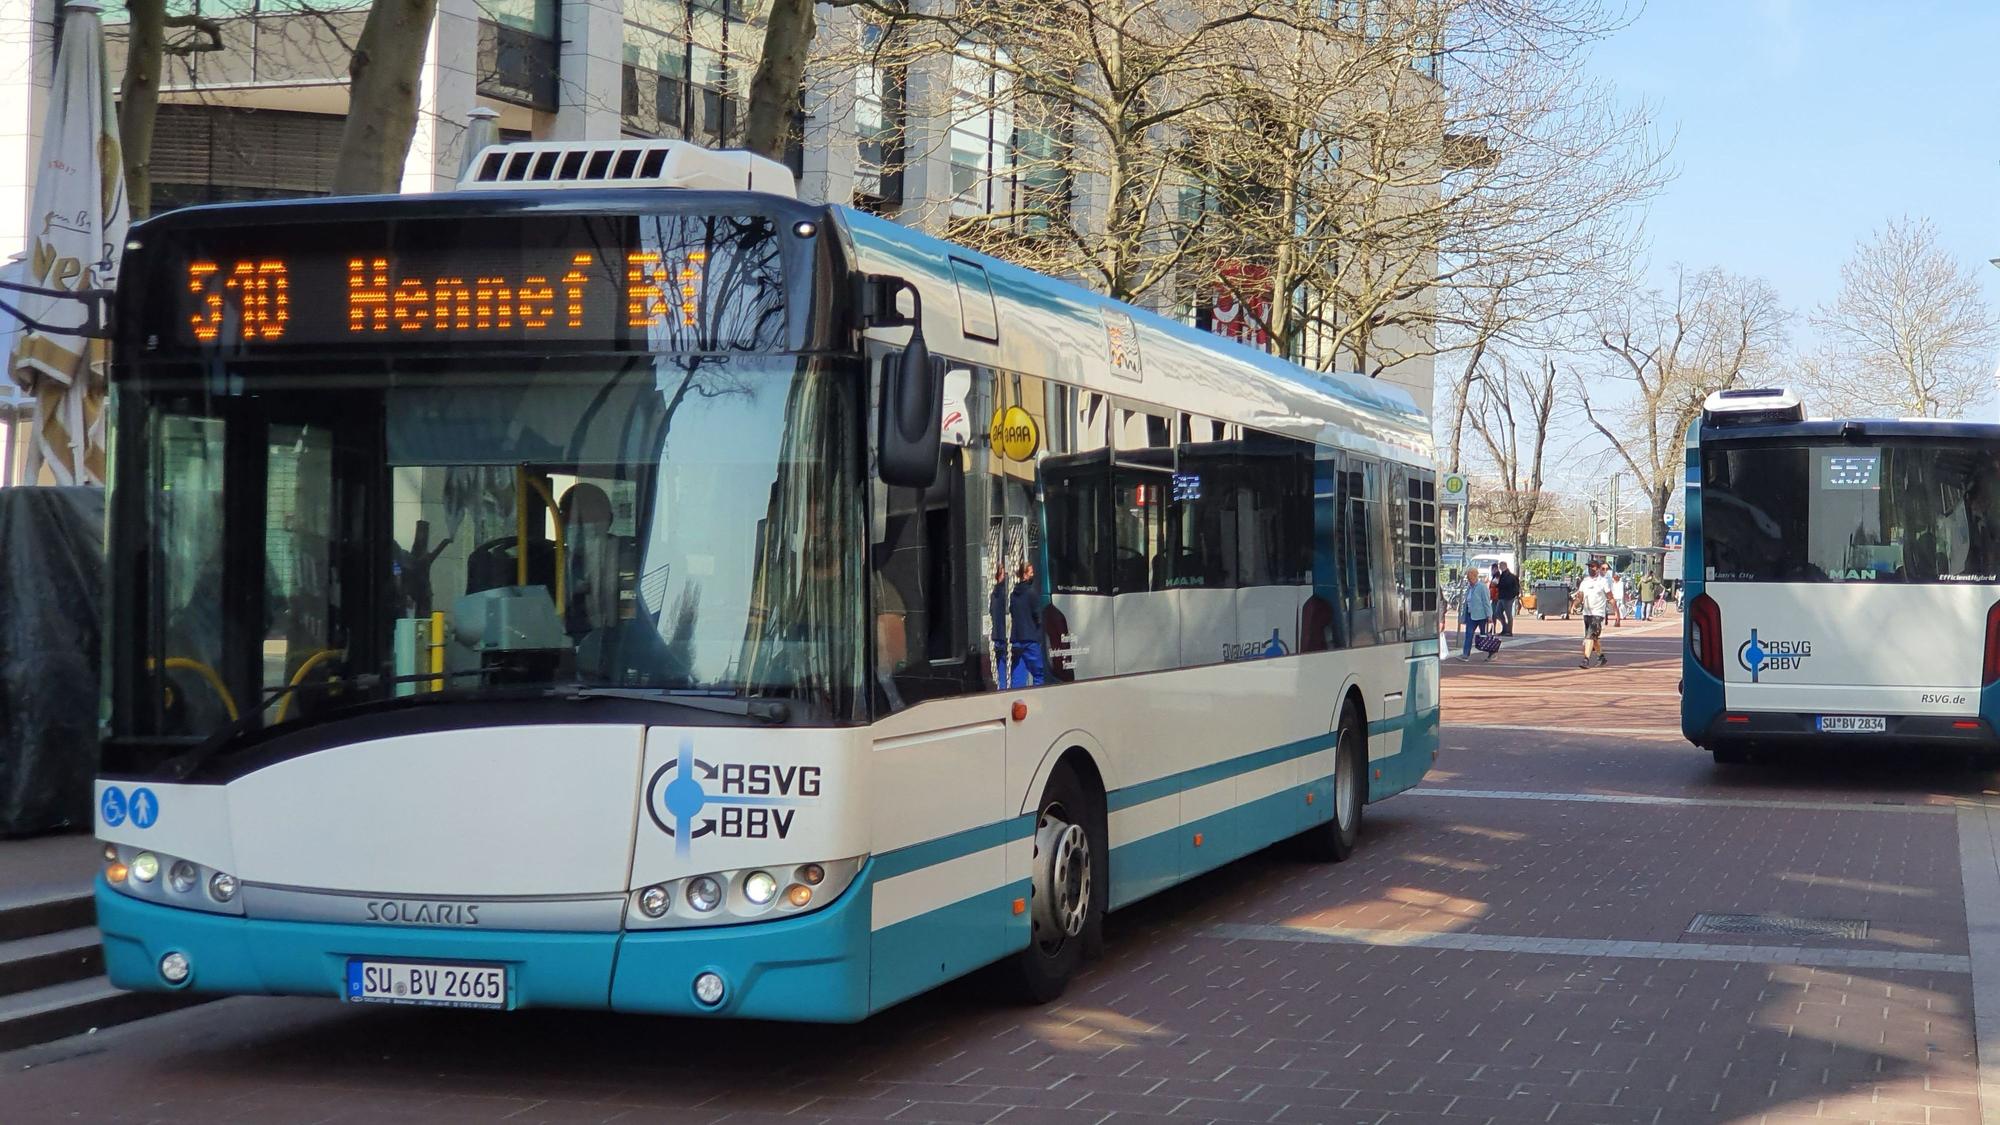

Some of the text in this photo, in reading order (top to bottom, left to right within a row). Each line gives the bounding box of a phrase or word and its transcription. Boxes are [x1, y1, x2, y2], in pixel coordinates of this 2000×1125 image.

[190, 260, 289, 339] 510
[350, 253, 592, 330] Hennef
[628, 252, 706, 327] Bf
[1829, 569, 1877, 580] MAN
[1769, 641, 1811, 654] RSVG
[1770, 657, 1801, 670] BBV
[1921, 694, 1966, 705] RSVG.de
[1822, 717, 1883, 730] SU BV 2834
[721, 763, 821, 797] RSVG
[720, 807, 796, 840] BBV
[366, 901, 479, 925] SOLARIS
[364, 966, 392, 994] SU
[410, 969, 438, 996] BV
[444, 971, 500, 999] 2665
